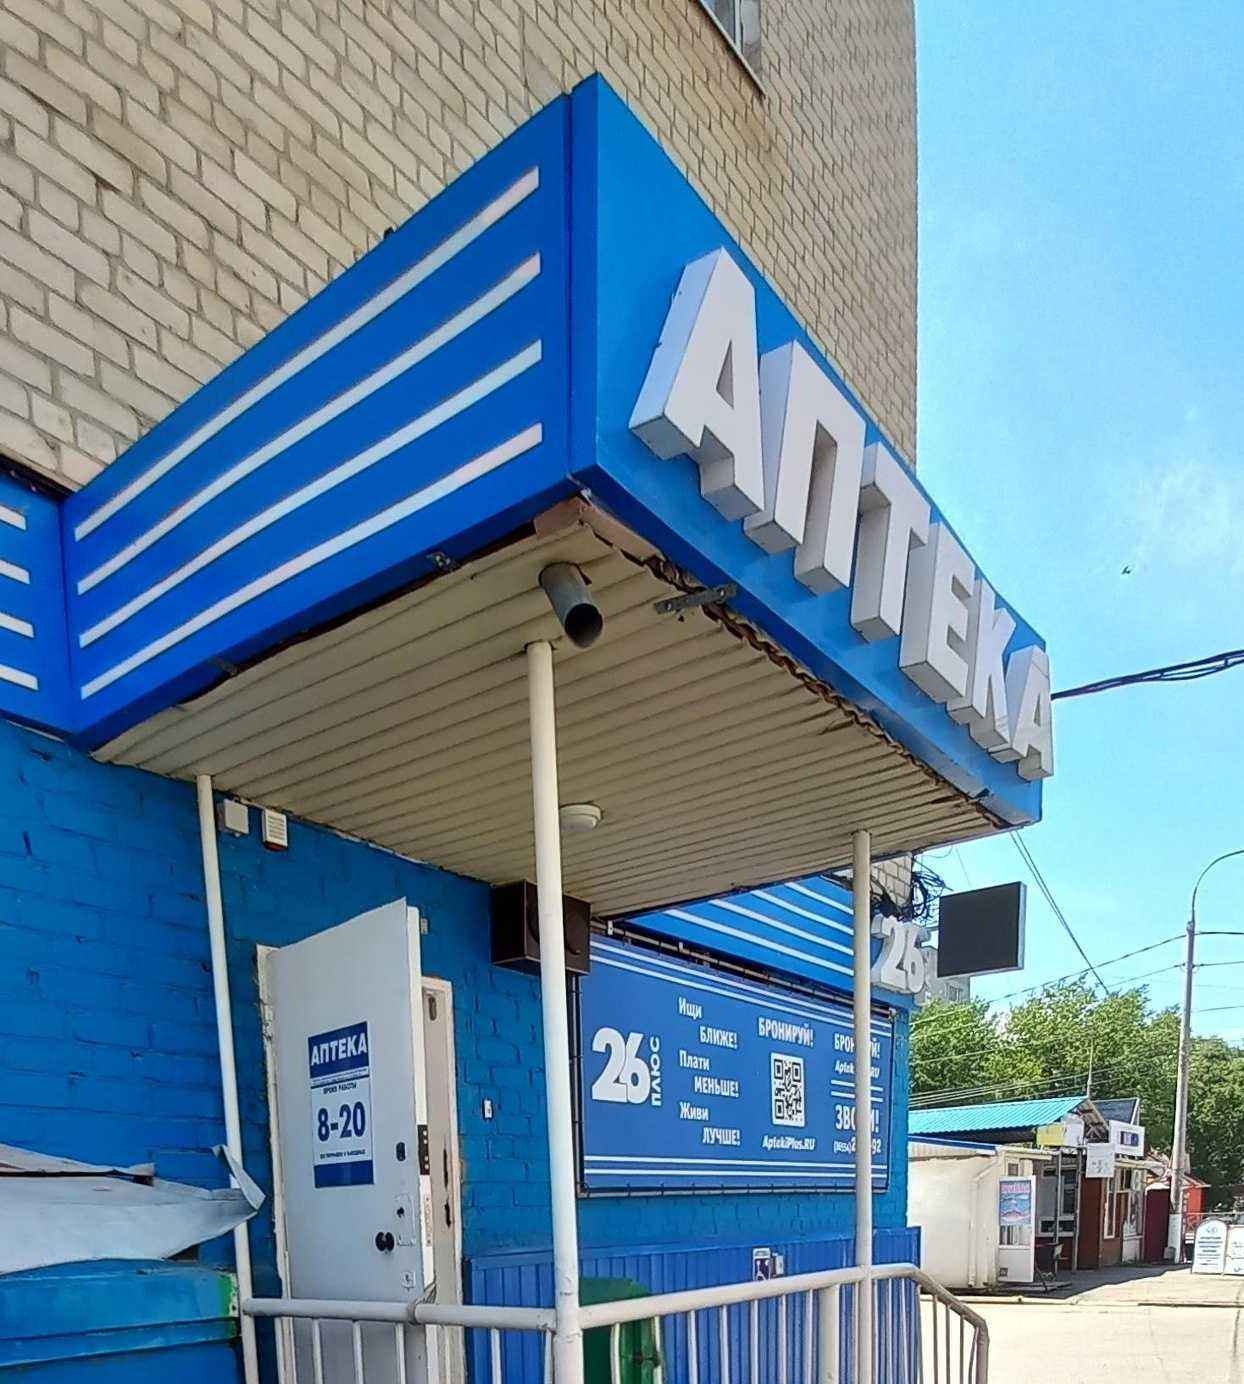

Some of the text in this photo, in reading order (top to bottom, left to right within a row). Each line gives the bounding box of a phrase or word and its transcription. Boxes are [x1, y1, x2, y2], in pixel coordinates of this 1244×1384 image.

[631, 246, 1054, 781] АПТЕКА
[873, 914, 925, 994] 26
[678, 997, 702, 1020] Ищи
[699, 1026, 738, 1049] БЛИЖЕ!
[758, 1017, 814, 1047] БРОНИРУЙ!
[311, 1040, 368, 1066] АПТЕКА
[679, 1050, 710, 1071] Плати
[592, 1027, 651, 1104] 26
[650, 1037, 661, 1106] ПЛЮС
[694, 1076, 739, 1098] МЕНЬШЕ!
[317, 1101, 366, 1142] 8-20
[680, 1102, 709, 1121] Живи
[702, 1127, 741, 1146] ЛУЧШЕ!
[762, 1135, 816, 1150] AptekiPlus.RU
